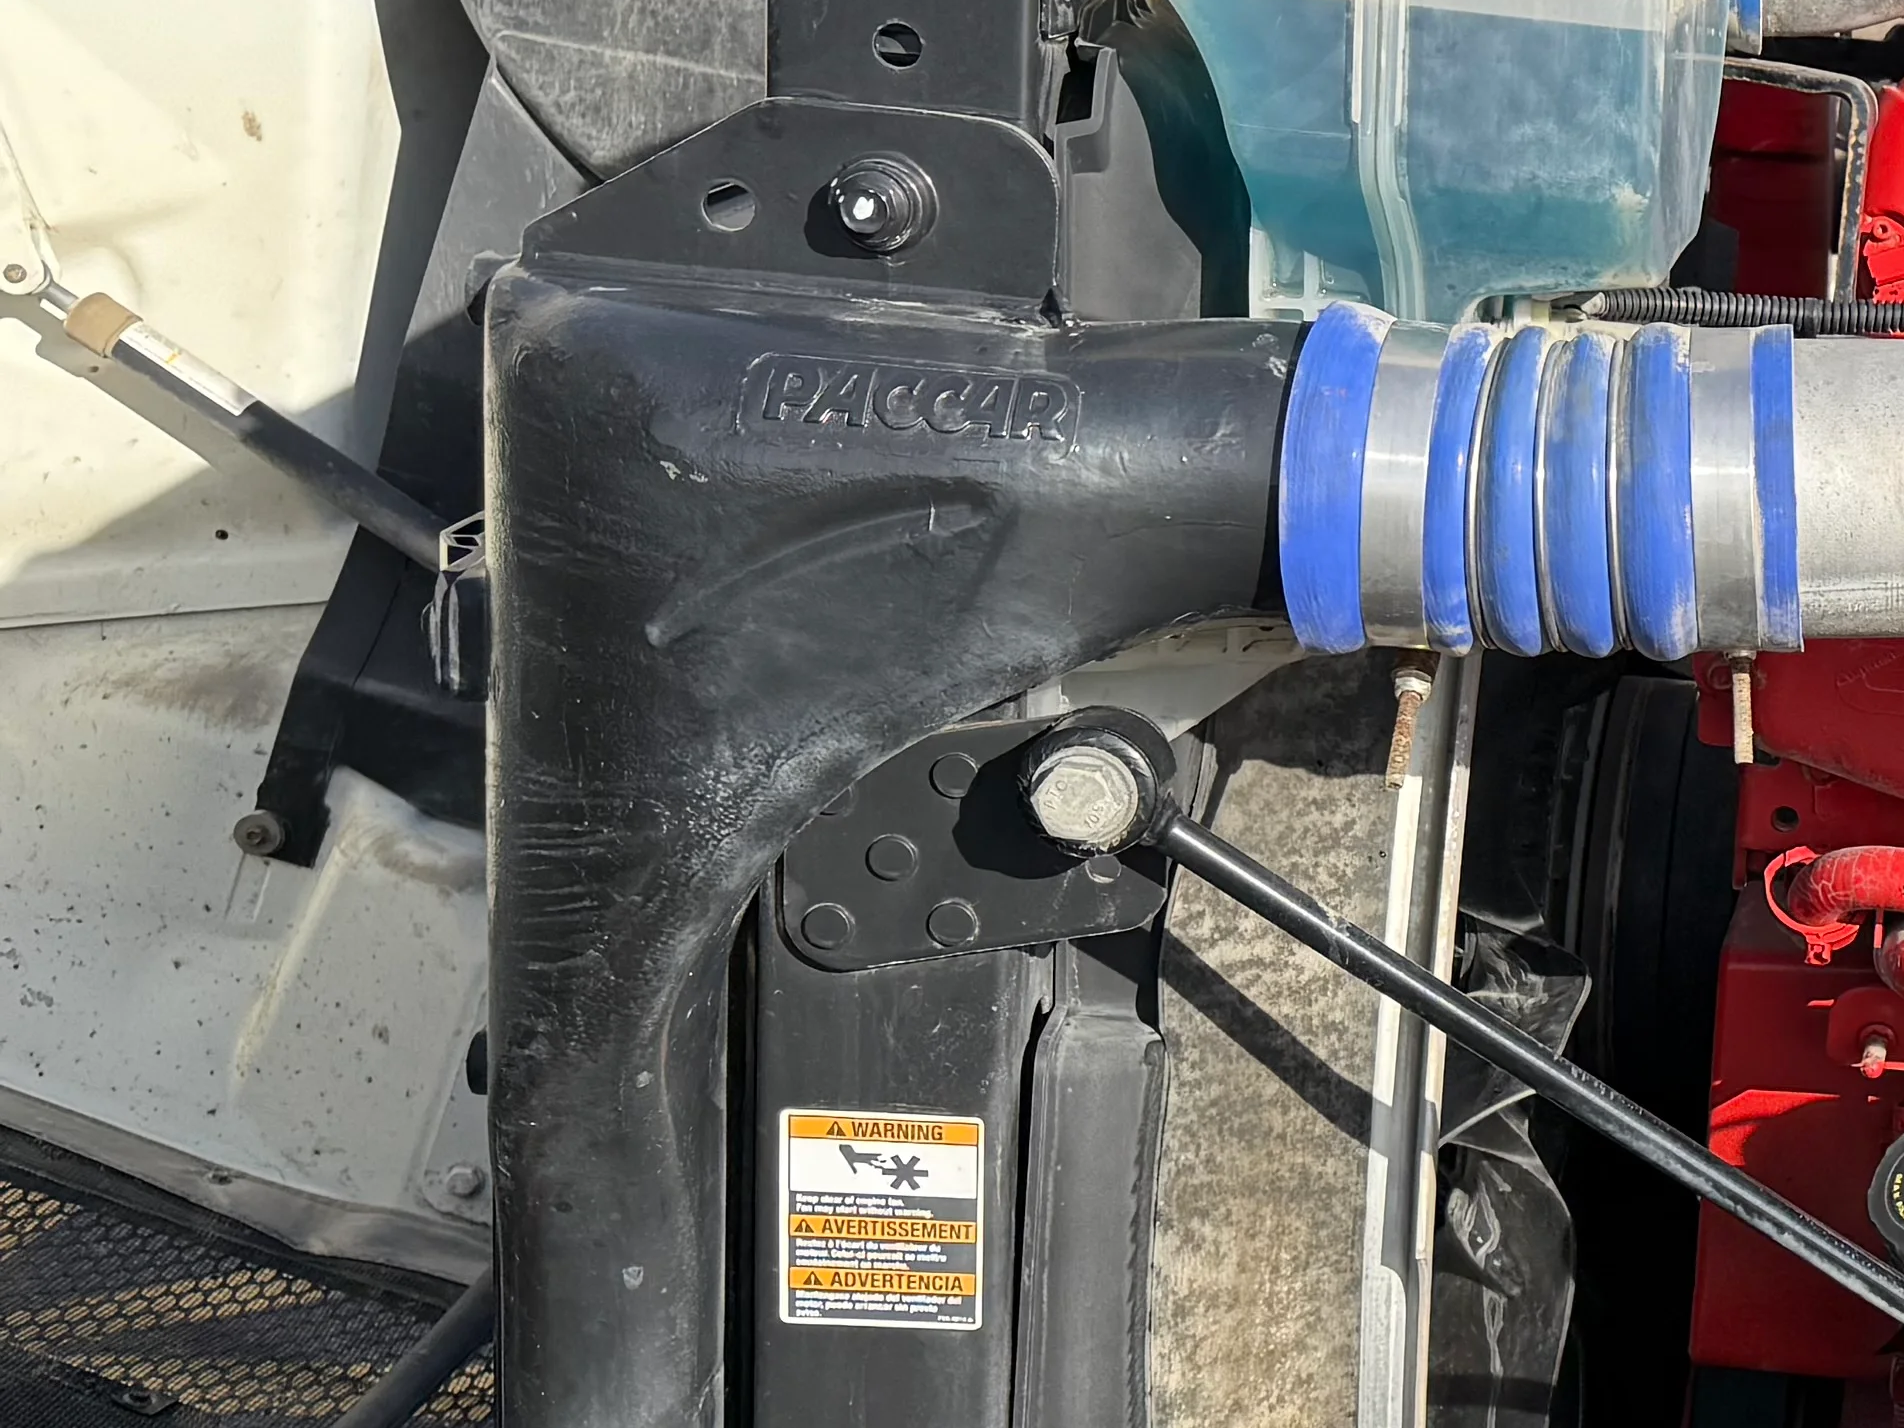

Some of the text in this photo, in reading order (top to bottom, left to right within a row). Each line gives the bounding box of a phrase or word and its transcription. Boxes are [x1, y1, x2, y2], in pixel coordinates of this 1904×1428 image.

[761, 367, 1067, 443] PACCAR
[851, 1121, 944, 1141] WARNING
[821, 1218, 973, 1240] AVERTISSEMENT
[830, 1271, 964, 1292] ADVERTENCIA
